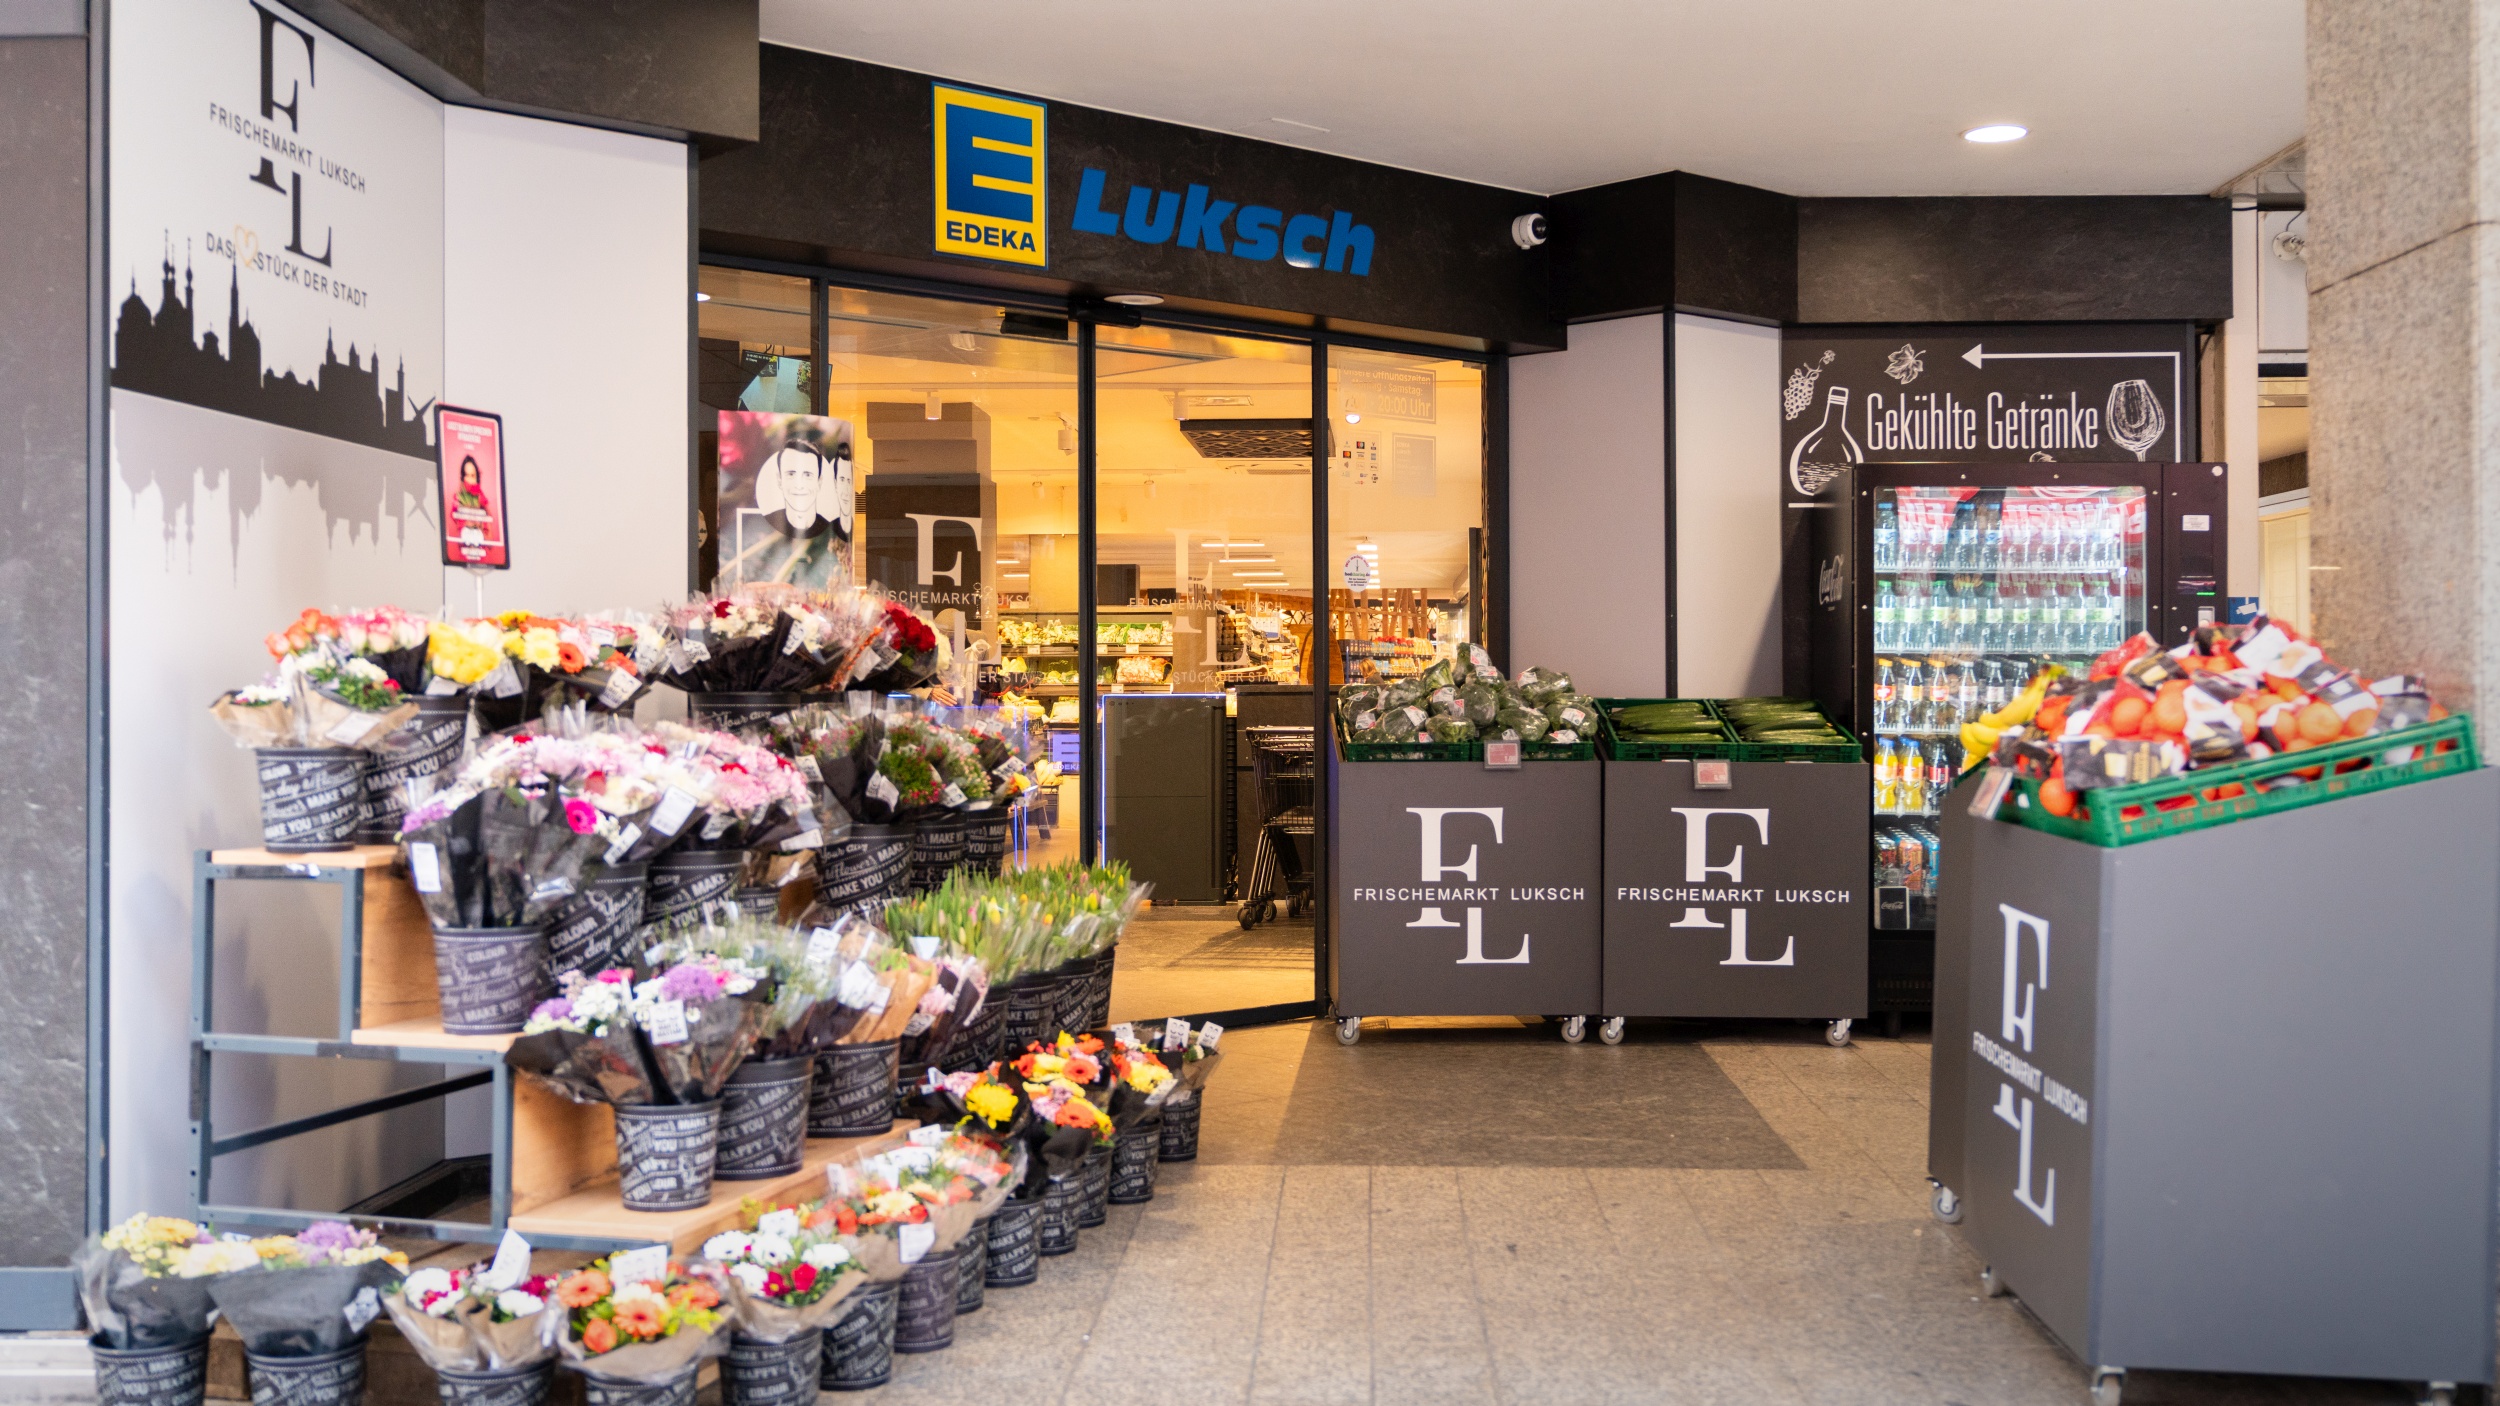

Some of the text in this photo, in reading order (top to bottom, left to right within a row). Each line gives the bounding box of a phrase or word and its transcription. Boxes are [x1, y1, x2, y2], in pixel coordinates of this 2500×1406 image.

[210, 103, 365, 193] FRISCHEMARKT LUKSCH
[285, 171, 332, 268] L
[1072, 168, 1376, 277] Luksch
[946, 221, 1036, 253] EDEKA
[206, 232, 235, 260] DAS
[304, 269, 329, 295] DER
[333, 281, 368, 309] STADT
[1378, 394, 1407, 415] 20:00
[1410, 398, 1431, 417] Uhr
[1867, 391, 2098, 450] Gekühlte Getränke
[873, 590, 980, 606] RISCHEMARKT
[1129, 597, 1282, 612] FRISCHEMARKT LUKSCH
[410, 756, 440, 778] YOU
[877, 842, 905, 862] MAKE
[929, 832, 956, 845] MAKE
[968, 843, 987, 854] YOU
[1406, 807, 1503, 927] F
[1670, 807, 1769, 929] F
[829, 881, 860, 900] MAKE
[861, 872, 884, 889] YOU
[1354, 888, 1584, 901] FRISCHEMARKT LUKSCH
[1618, 888, 1851, 903] FRISCHEMARKT LUKSCH
[1456, 907, 1530, 964] L
[1720, 908, 1794, 966] L
[1993, 903, 2049, 1130] F
[838, 1085, 871, 1106] MAKE
[741, 1116, 765, 1135] YOU
[654, 1139, 678, 1152] YOU
[2013, 1097, 2056, 1226] L
